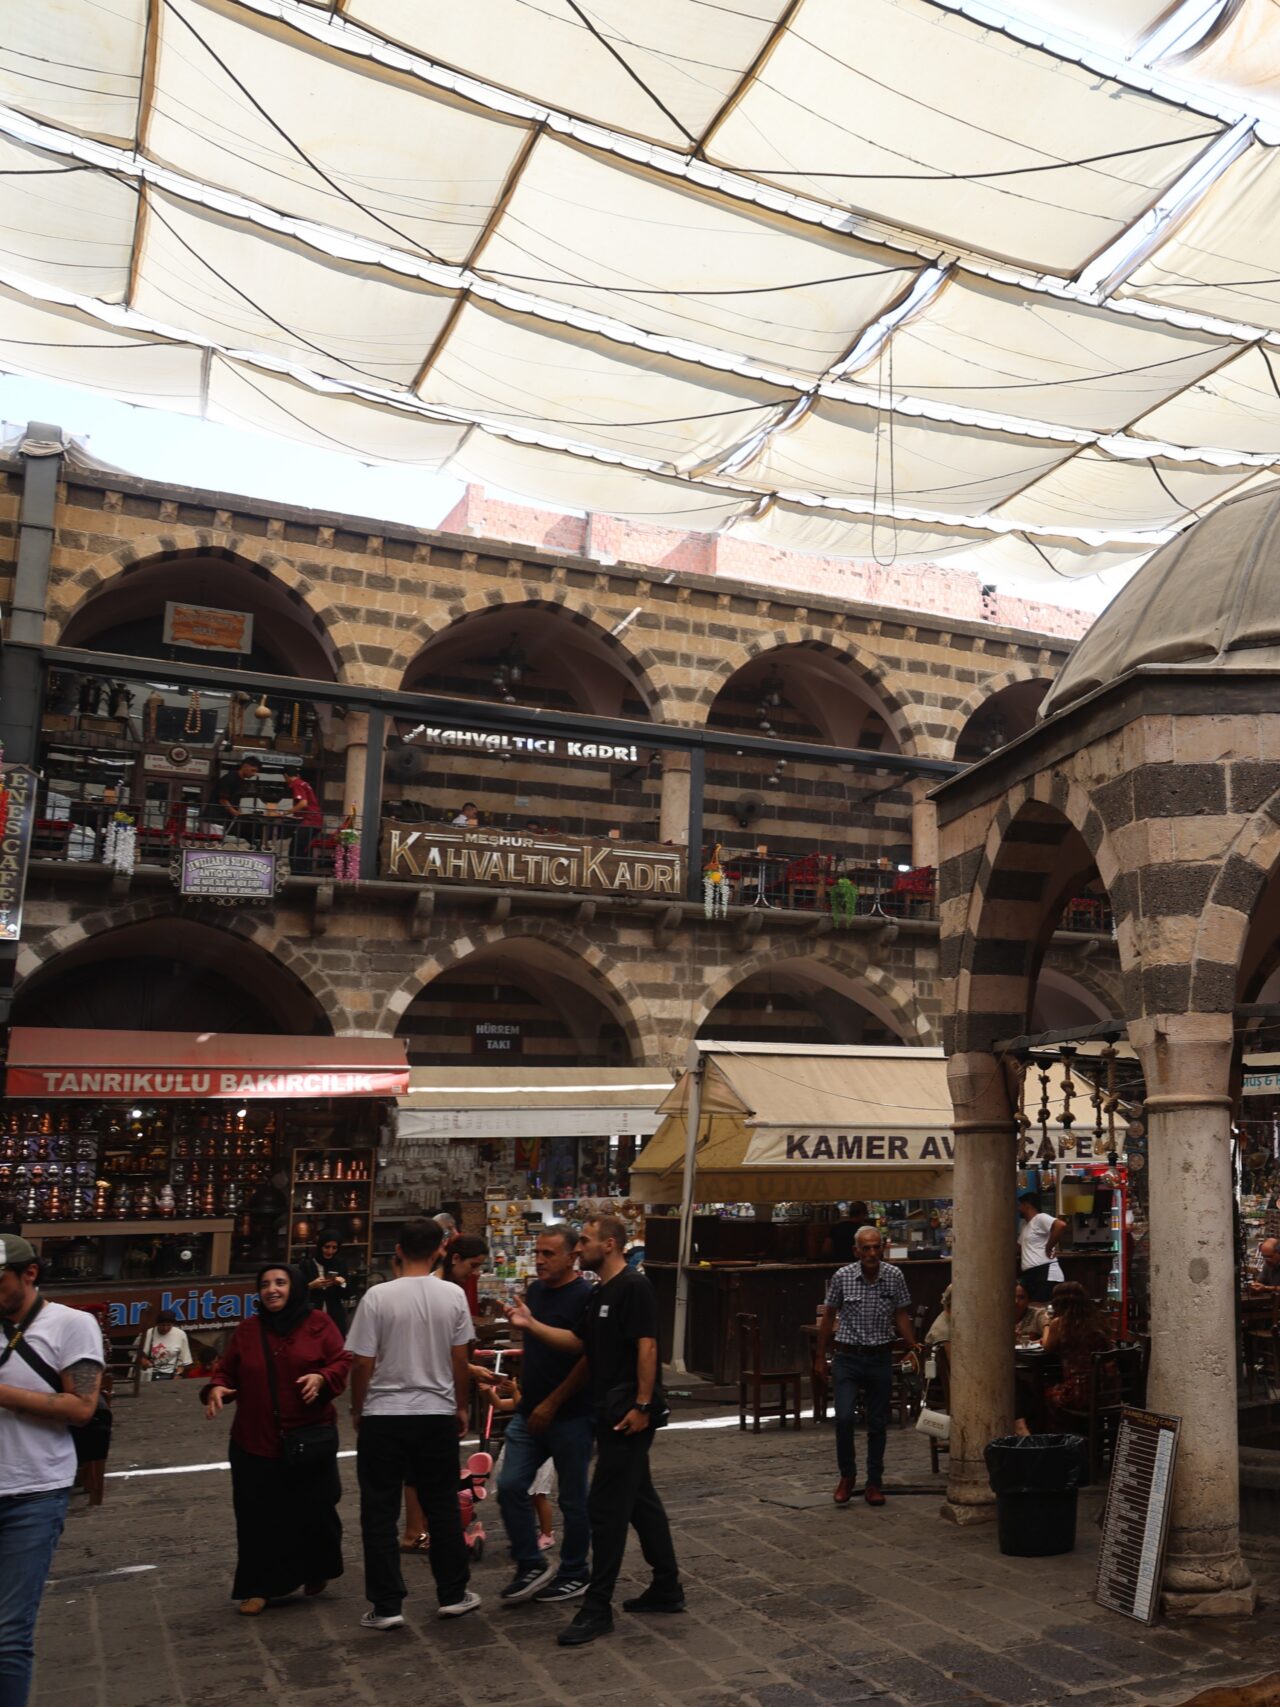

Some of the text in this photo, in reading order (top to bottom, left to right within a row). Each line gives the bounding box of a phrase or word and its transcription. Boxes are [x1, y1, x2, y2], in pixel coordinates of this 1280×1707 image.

[425, 727, 638, 762] KAHVALTICI KADRİ
[464, 832, 535, 849] MEŞHUR
[387, 830, 682, 893] KAHVALTICI KADRİ
[475, 1022, 520, 1035] HÜRREM
[486, 1039, 511, 1049] TAKI
[43, 1071, 211, 1093] TANRIKULU
[219, 1072, 374, 1093] BAKIRCILIK
[786, 1134, 910, 1159] KAMER
[919, 1135, 956, 1159] AV
